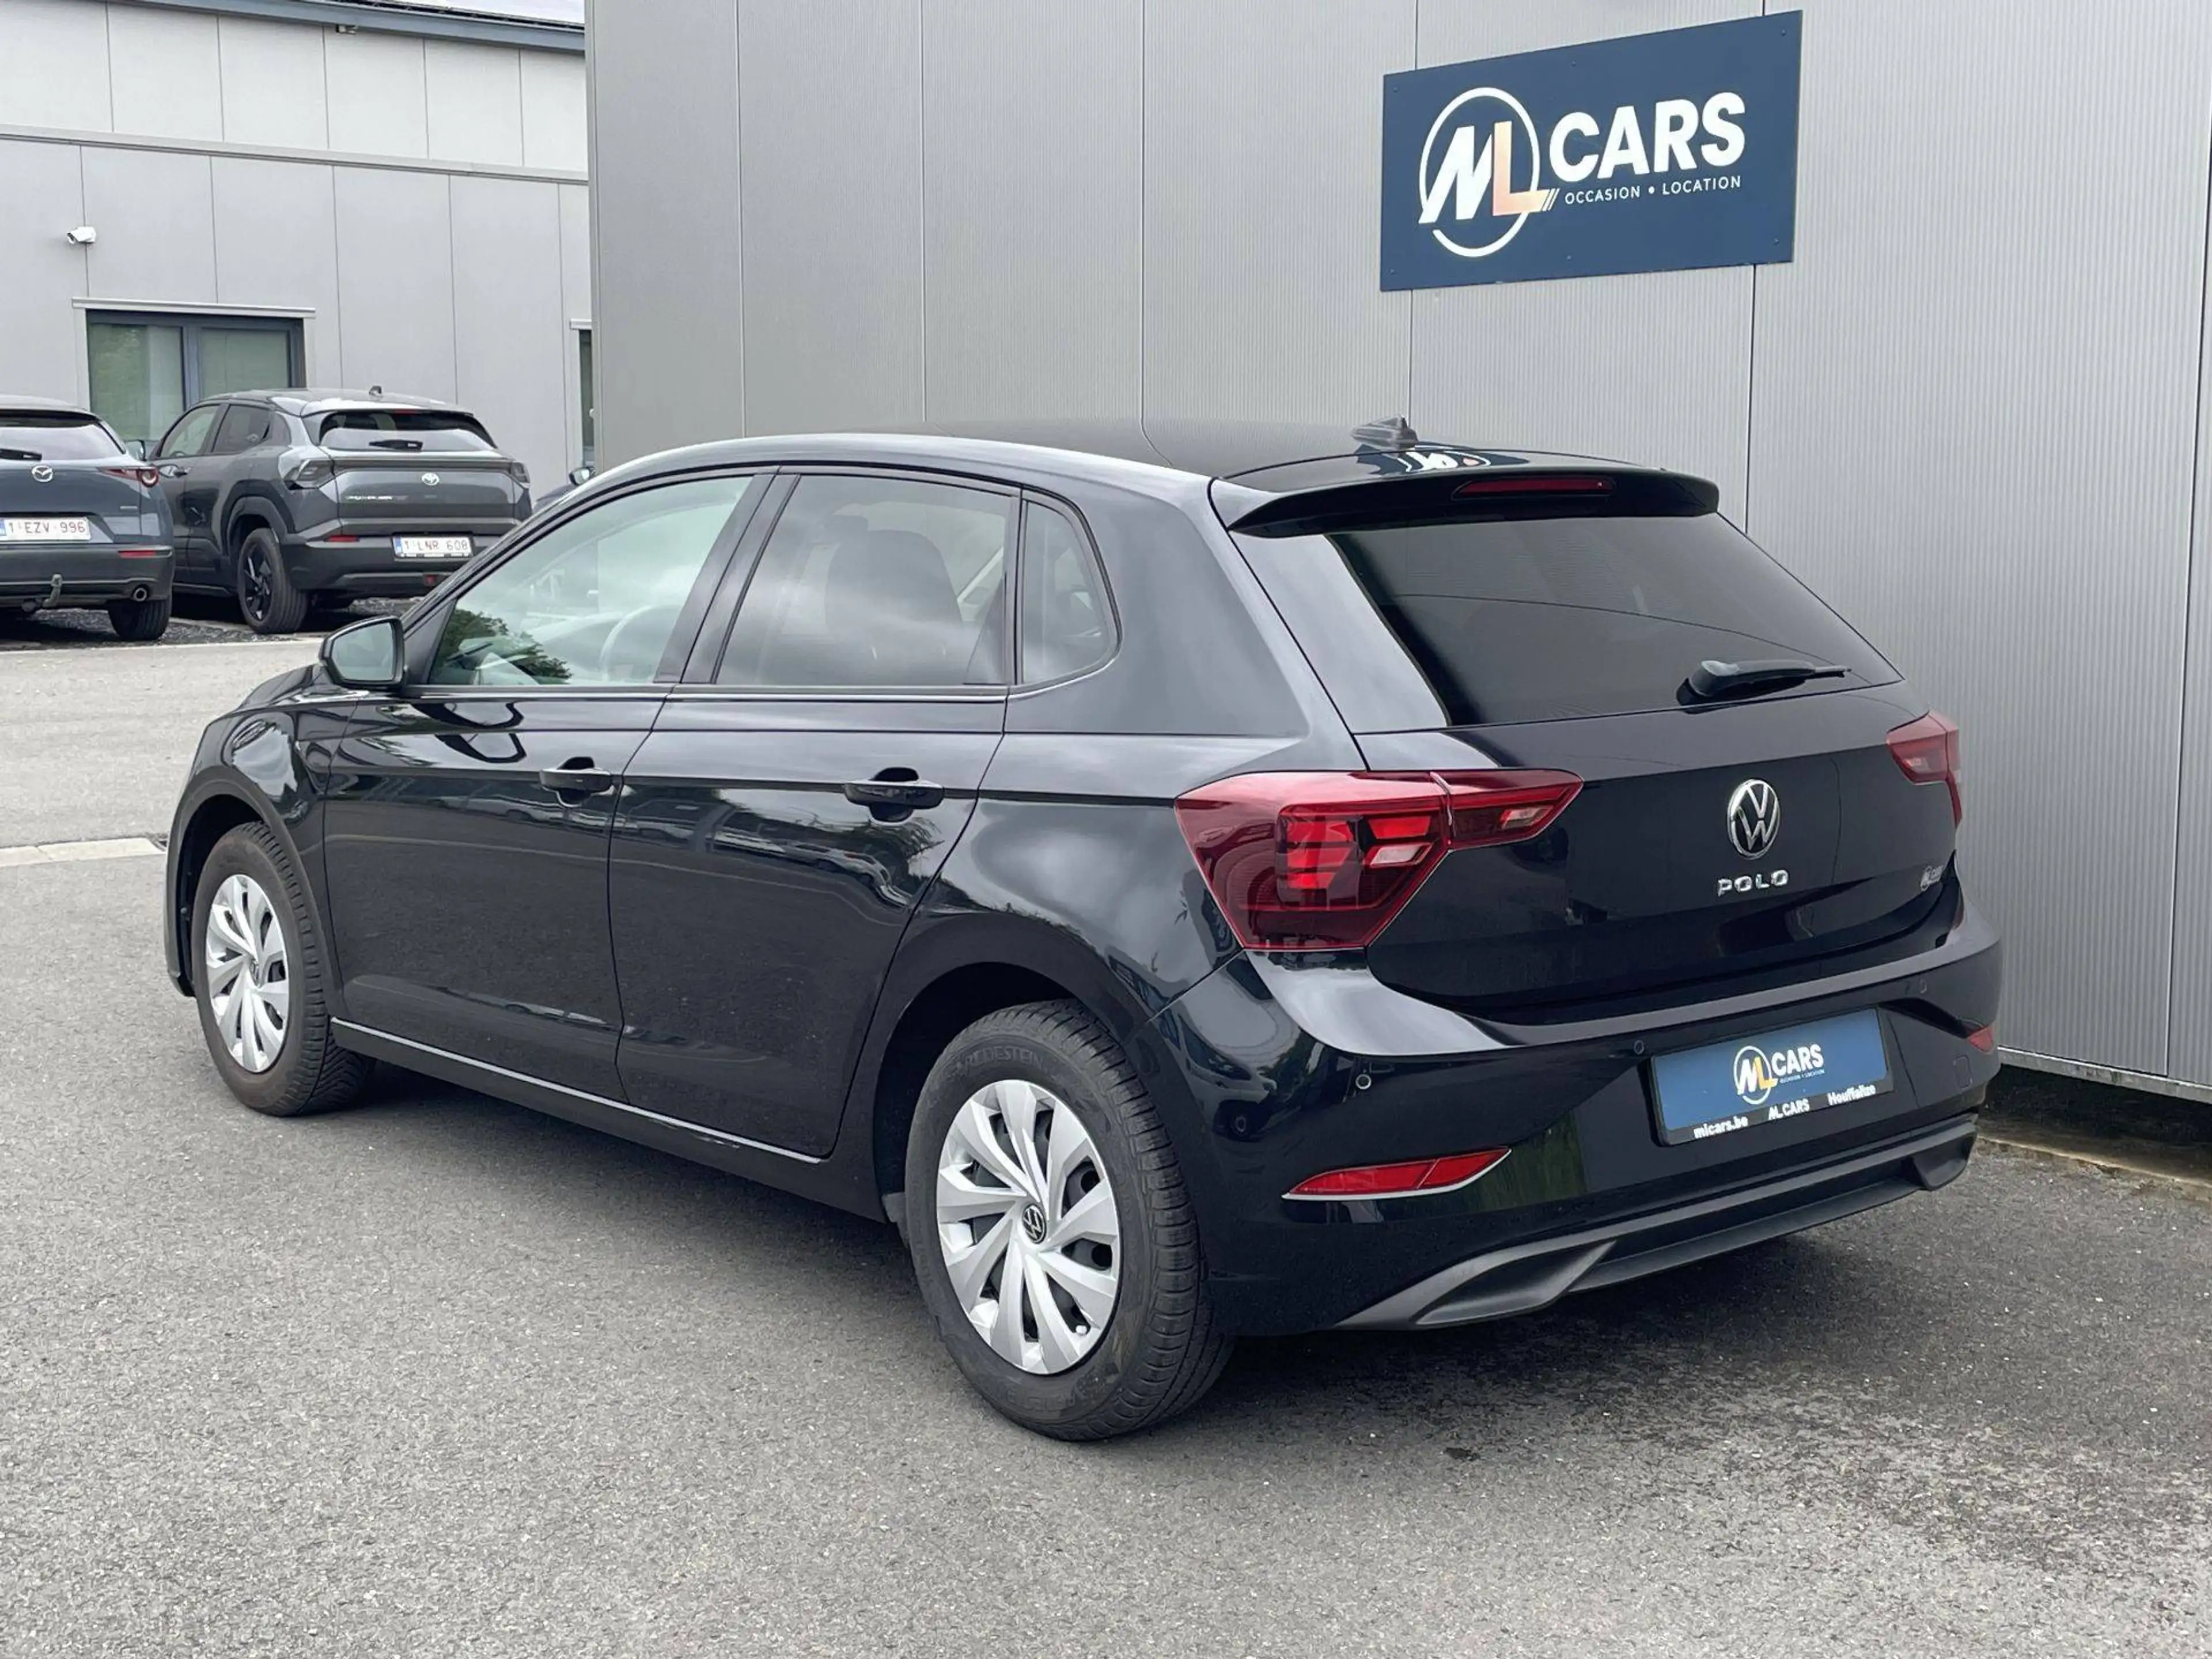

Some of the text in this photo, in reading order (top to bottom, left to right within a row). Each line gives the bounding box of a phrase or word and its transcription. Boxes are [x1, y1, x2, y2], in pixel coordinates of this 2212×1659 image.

[1550, 92, 1745, 182] CARS
[1565, 175, 1741, 206] OCCASION LOCATION
[1717, 869, 1789, 897] POLO
[1771, 1043, 1824, 1077] CARS
[1782, 1098, 1810, 1116] CARS
